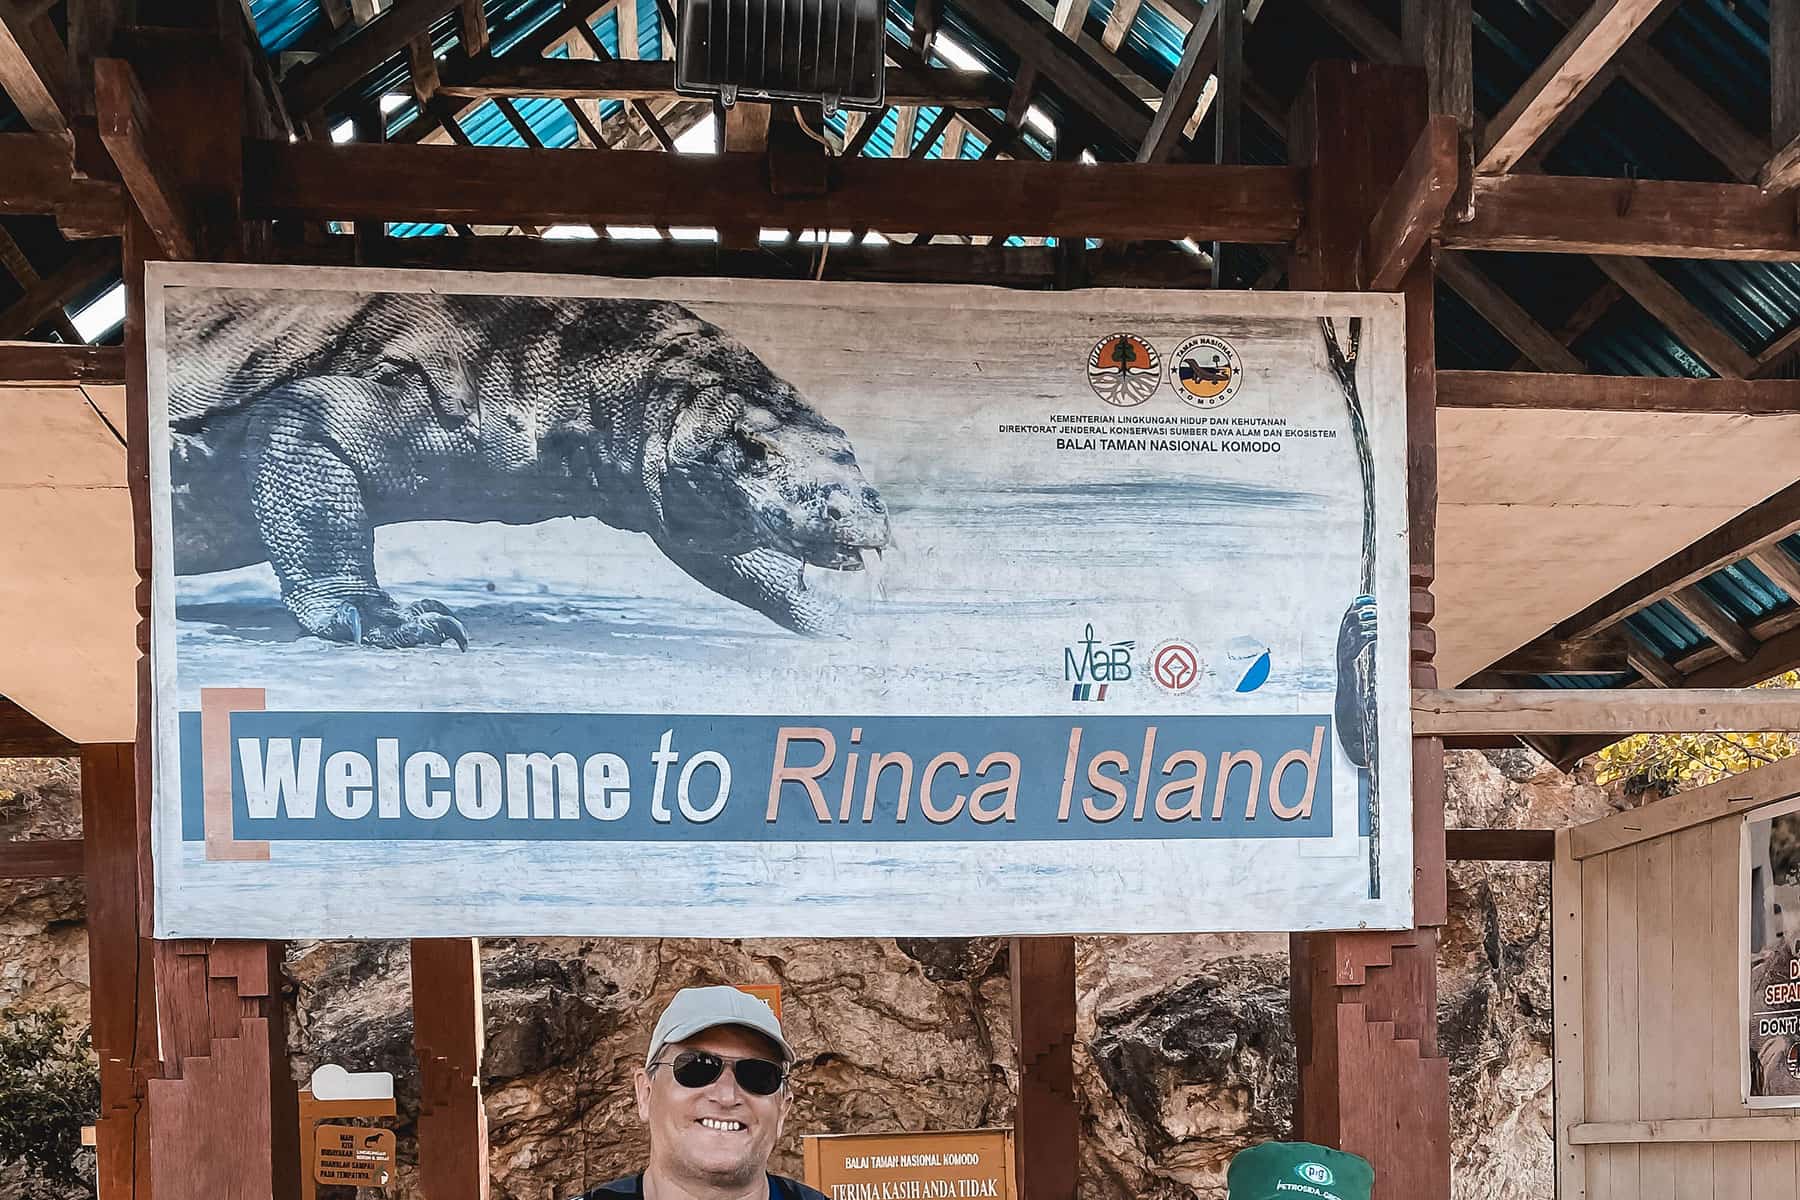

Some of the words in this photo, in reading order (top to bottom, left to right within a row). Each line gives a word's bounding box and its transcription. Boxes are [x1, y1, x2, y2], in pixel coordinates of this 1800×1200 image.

[1176, 338, 1199, 358] TAMAN
[1200, 338, 1234, 360] NASIONAL
[1178, 387, 1233, 405] KOMODO
[1050, 415, 1115, 424] KEMENTERIAN
[1117, 416, 1178, 425] LINGKUNGAN
[1180, 417, 1208, 425] HIDUP
[1209, 417, 1229, 426] DAN
[1231, 418, 1287, 426] KEHUTANAN
[999, 425, 1057, 434] DIREKTORAT
[1059, 426, 1107, 435] JENDERAL
[1109, 427, 1167, 435] KONSERVASI
[1169, 428, 1208, 436] SUMBER
[1211, 428, 1234, 437] DAYA
[1235, 429, 1261, 437] ALAM
[1263, 429, 1282, 437] DAN
[1284, 430, 1337, 438] EKOSISTEM
[1056, 438, 1096, 451] BALAI
[1099, 439, 1146, 451] TAMAN
[1149, 439, 1218, 452] NASIONAL
[1221, 440, 1281, 453] KOMODO
[237, 736, 632, 822] Welcome
[650, 728, 732, 824] to
[765, 726, 1023, 825] Rinca
[1056, 726, 1326, 823] Island
[1759, 1017, 1797, 1035] DON'T
[845, 1155, 869, 1169] BALAI
[871, 1155, 899, 1169] TAMAN
[900, 1153, 942, 1168] NASIONAL
[943, 1153, 979, 1166] KOMODO
[882, 1180, 920, 1200] KASIH
[922, 1179, 957, 1199] ANDA
[957, 1178, 998, 1198] TIDAK
